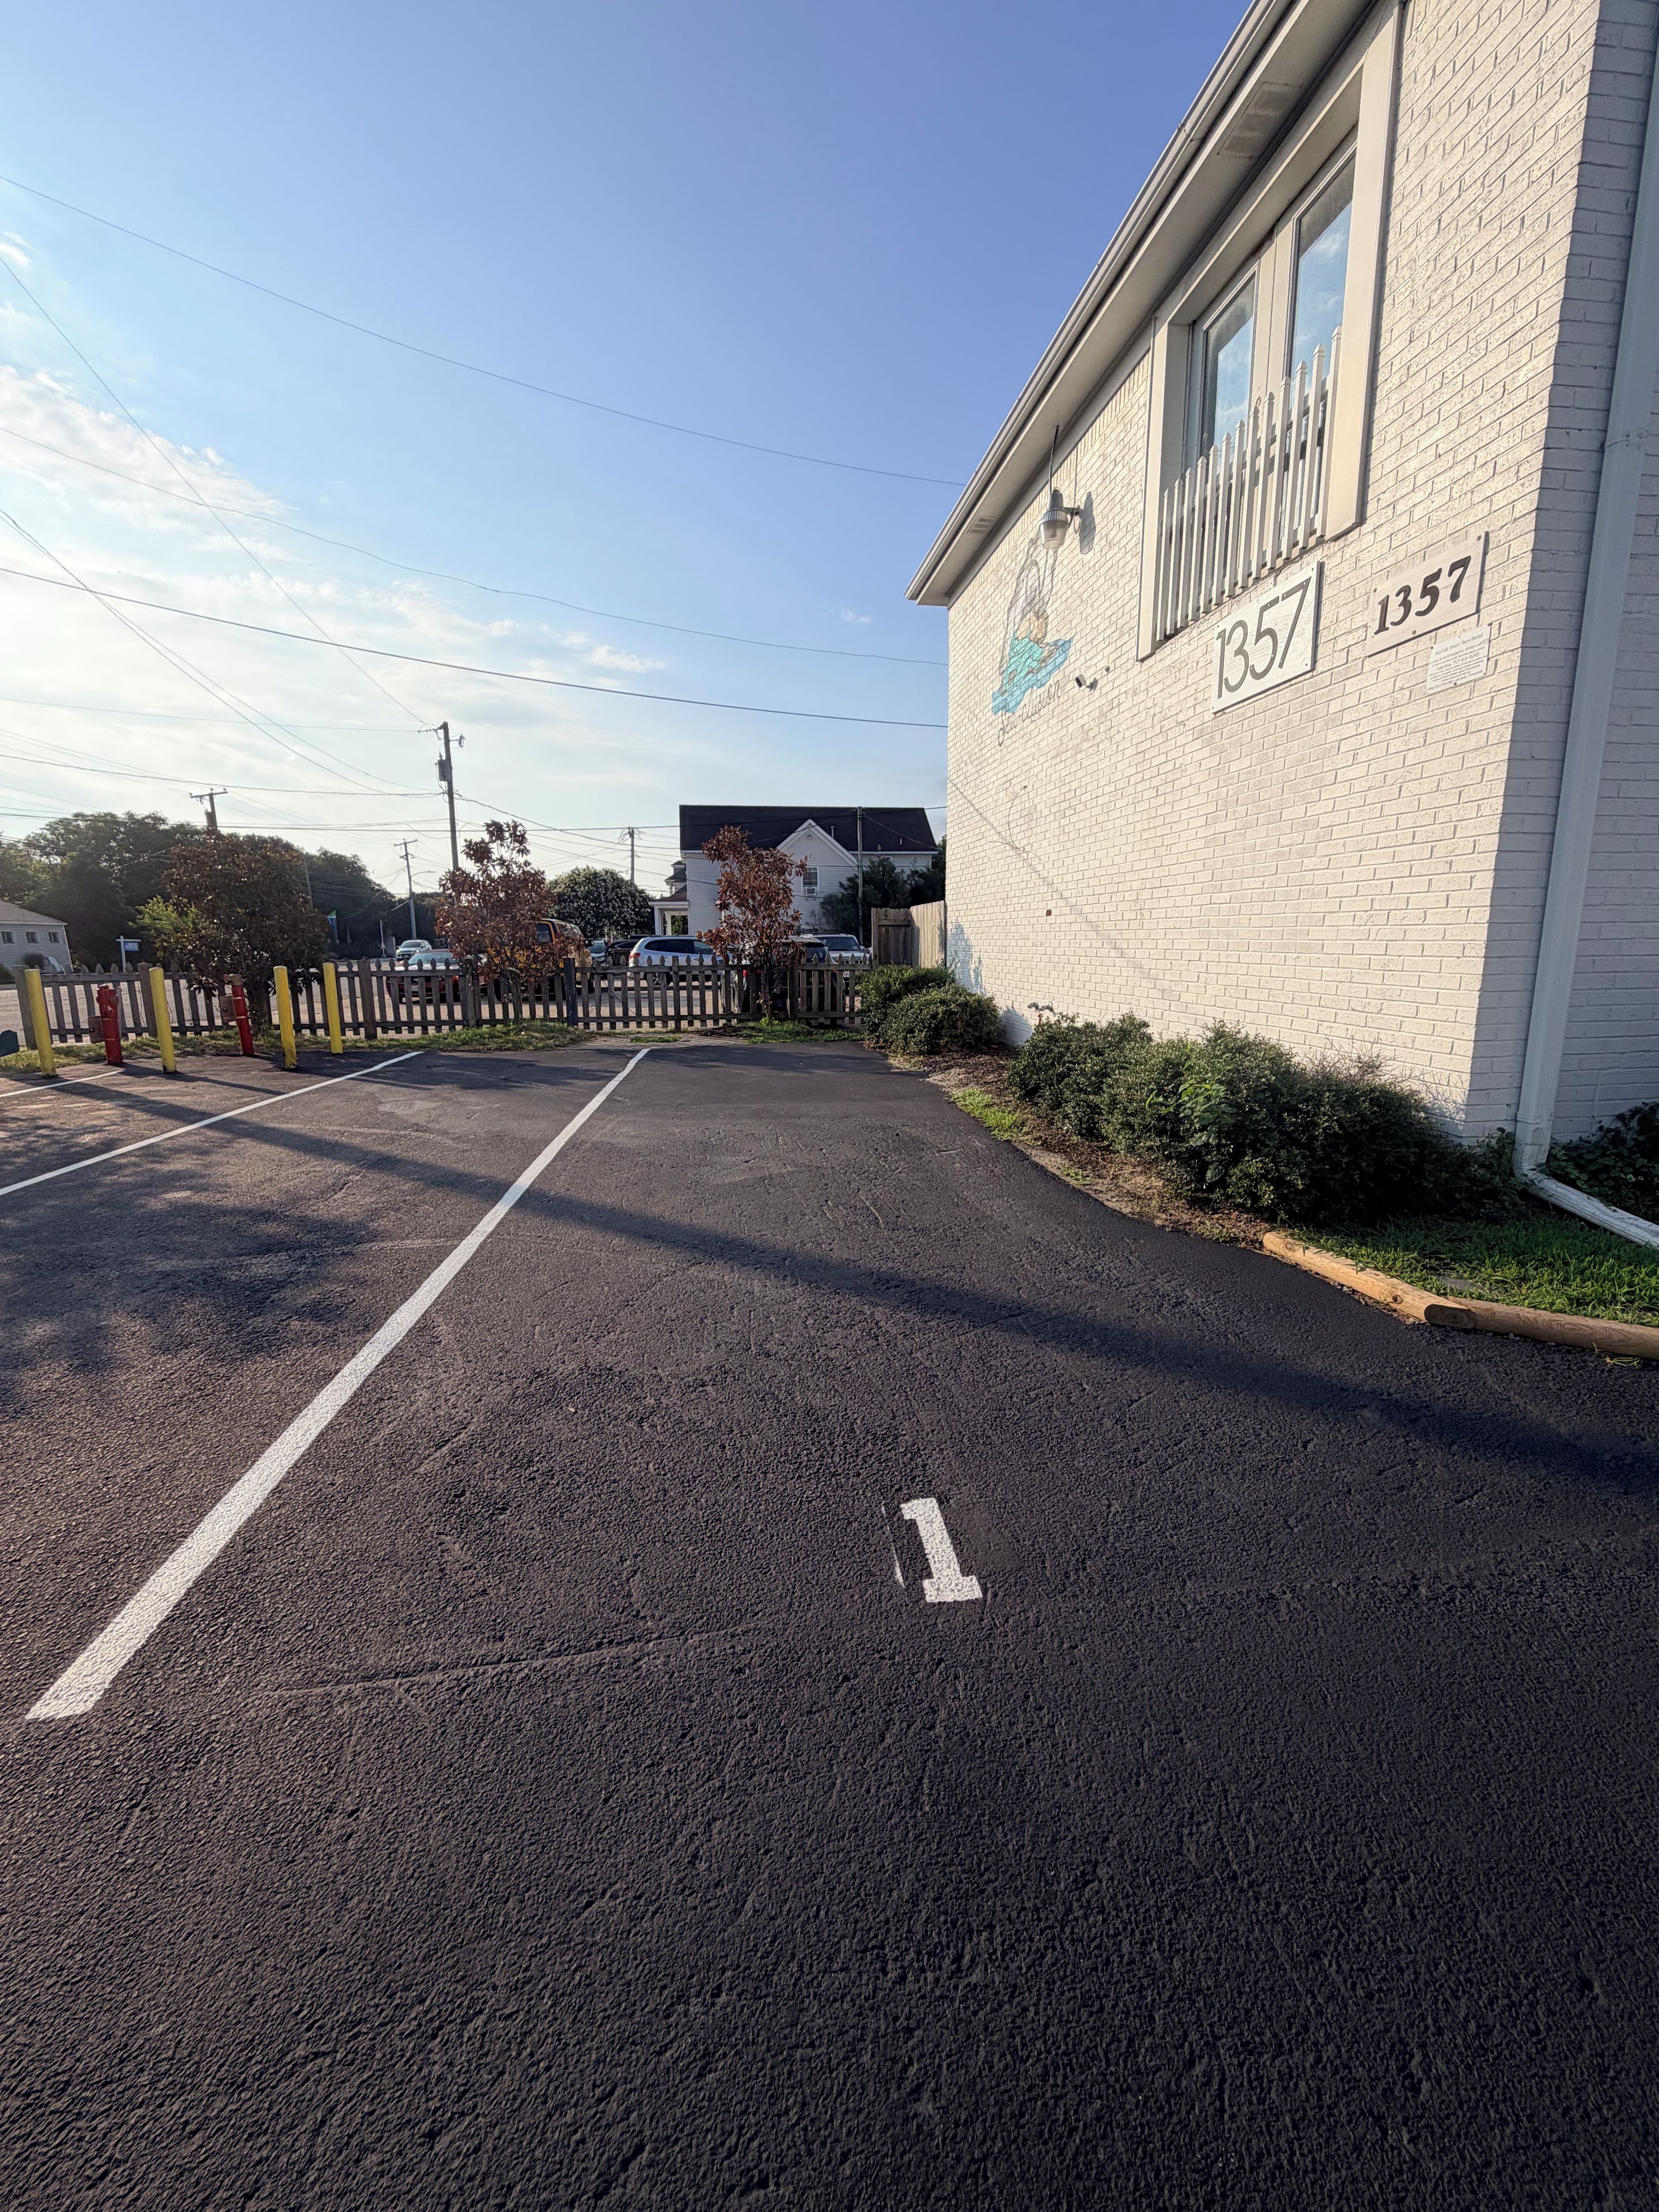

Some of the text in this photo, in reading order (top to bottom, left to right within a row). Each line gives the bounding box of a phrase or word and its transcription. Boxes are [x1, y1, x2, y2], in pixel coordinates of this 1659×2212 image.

[1215, 576, 1312, 699] 1357
[1374, 555, 1471, 635] 1357
[900, 1497, 983, 1603] 1
